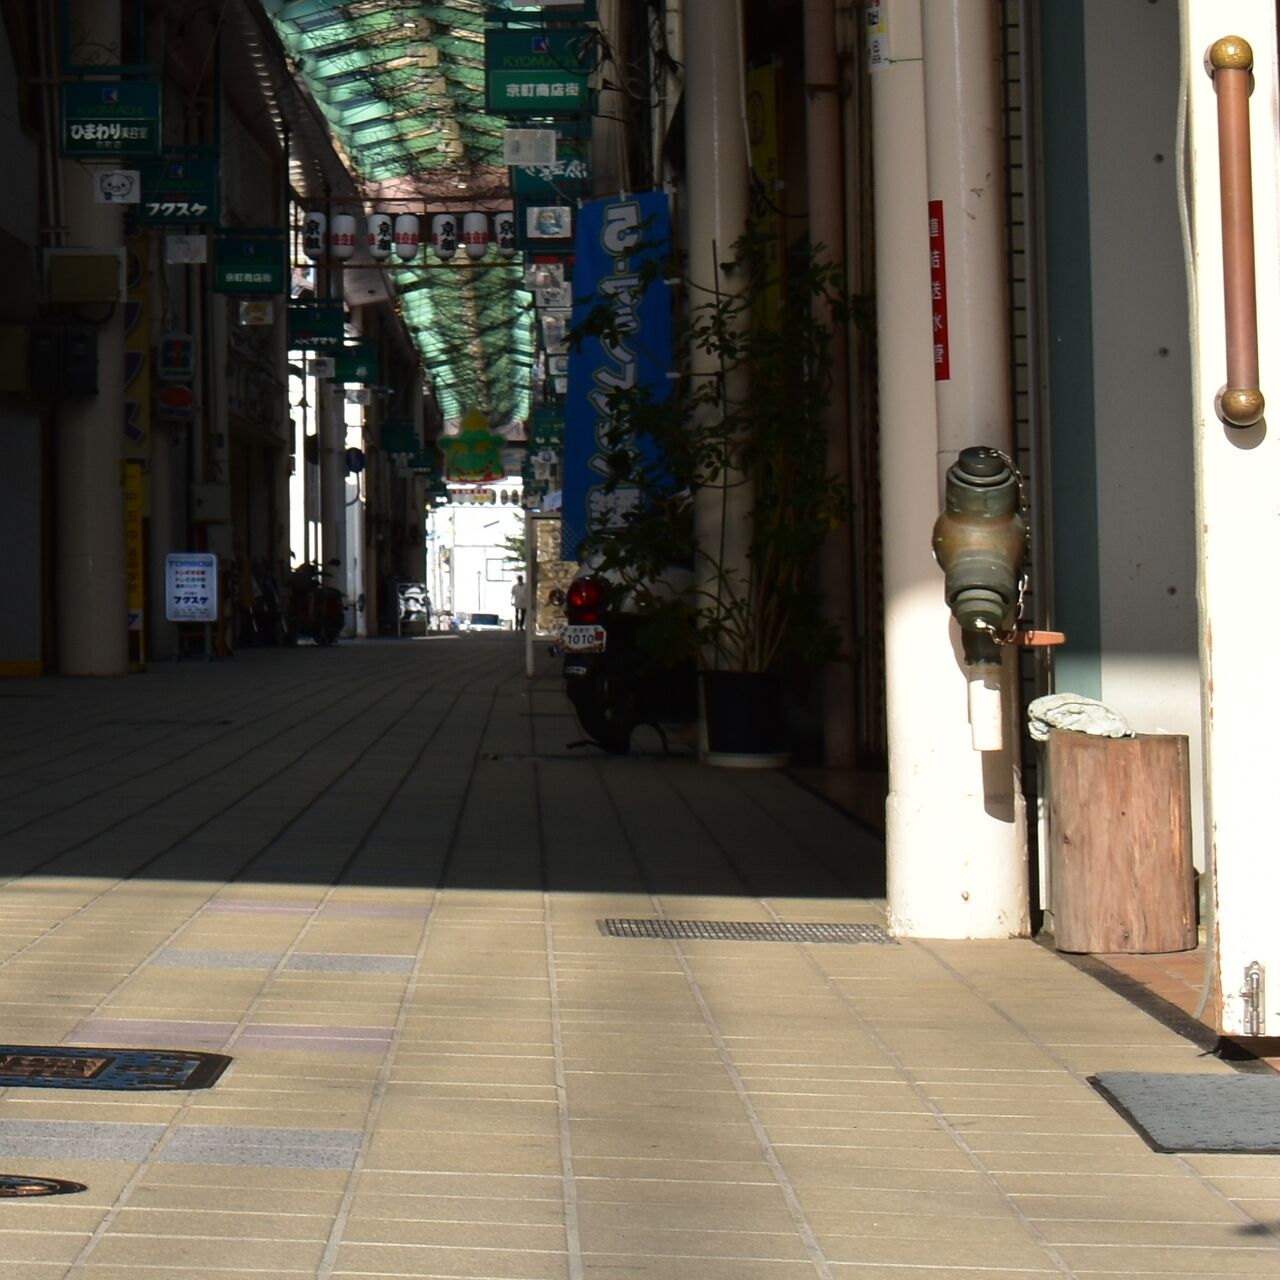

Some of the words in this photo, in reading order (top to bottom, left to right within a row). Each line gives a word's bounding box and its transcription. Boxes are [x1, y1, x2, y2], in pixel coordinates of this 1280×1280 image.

[506, 83, 580, 97] 京町商店街
[146, 202, 207, 216] フクスケ
[174, 596, 208, 604] フクスケ
[568, 634, 594, 644] 1010
